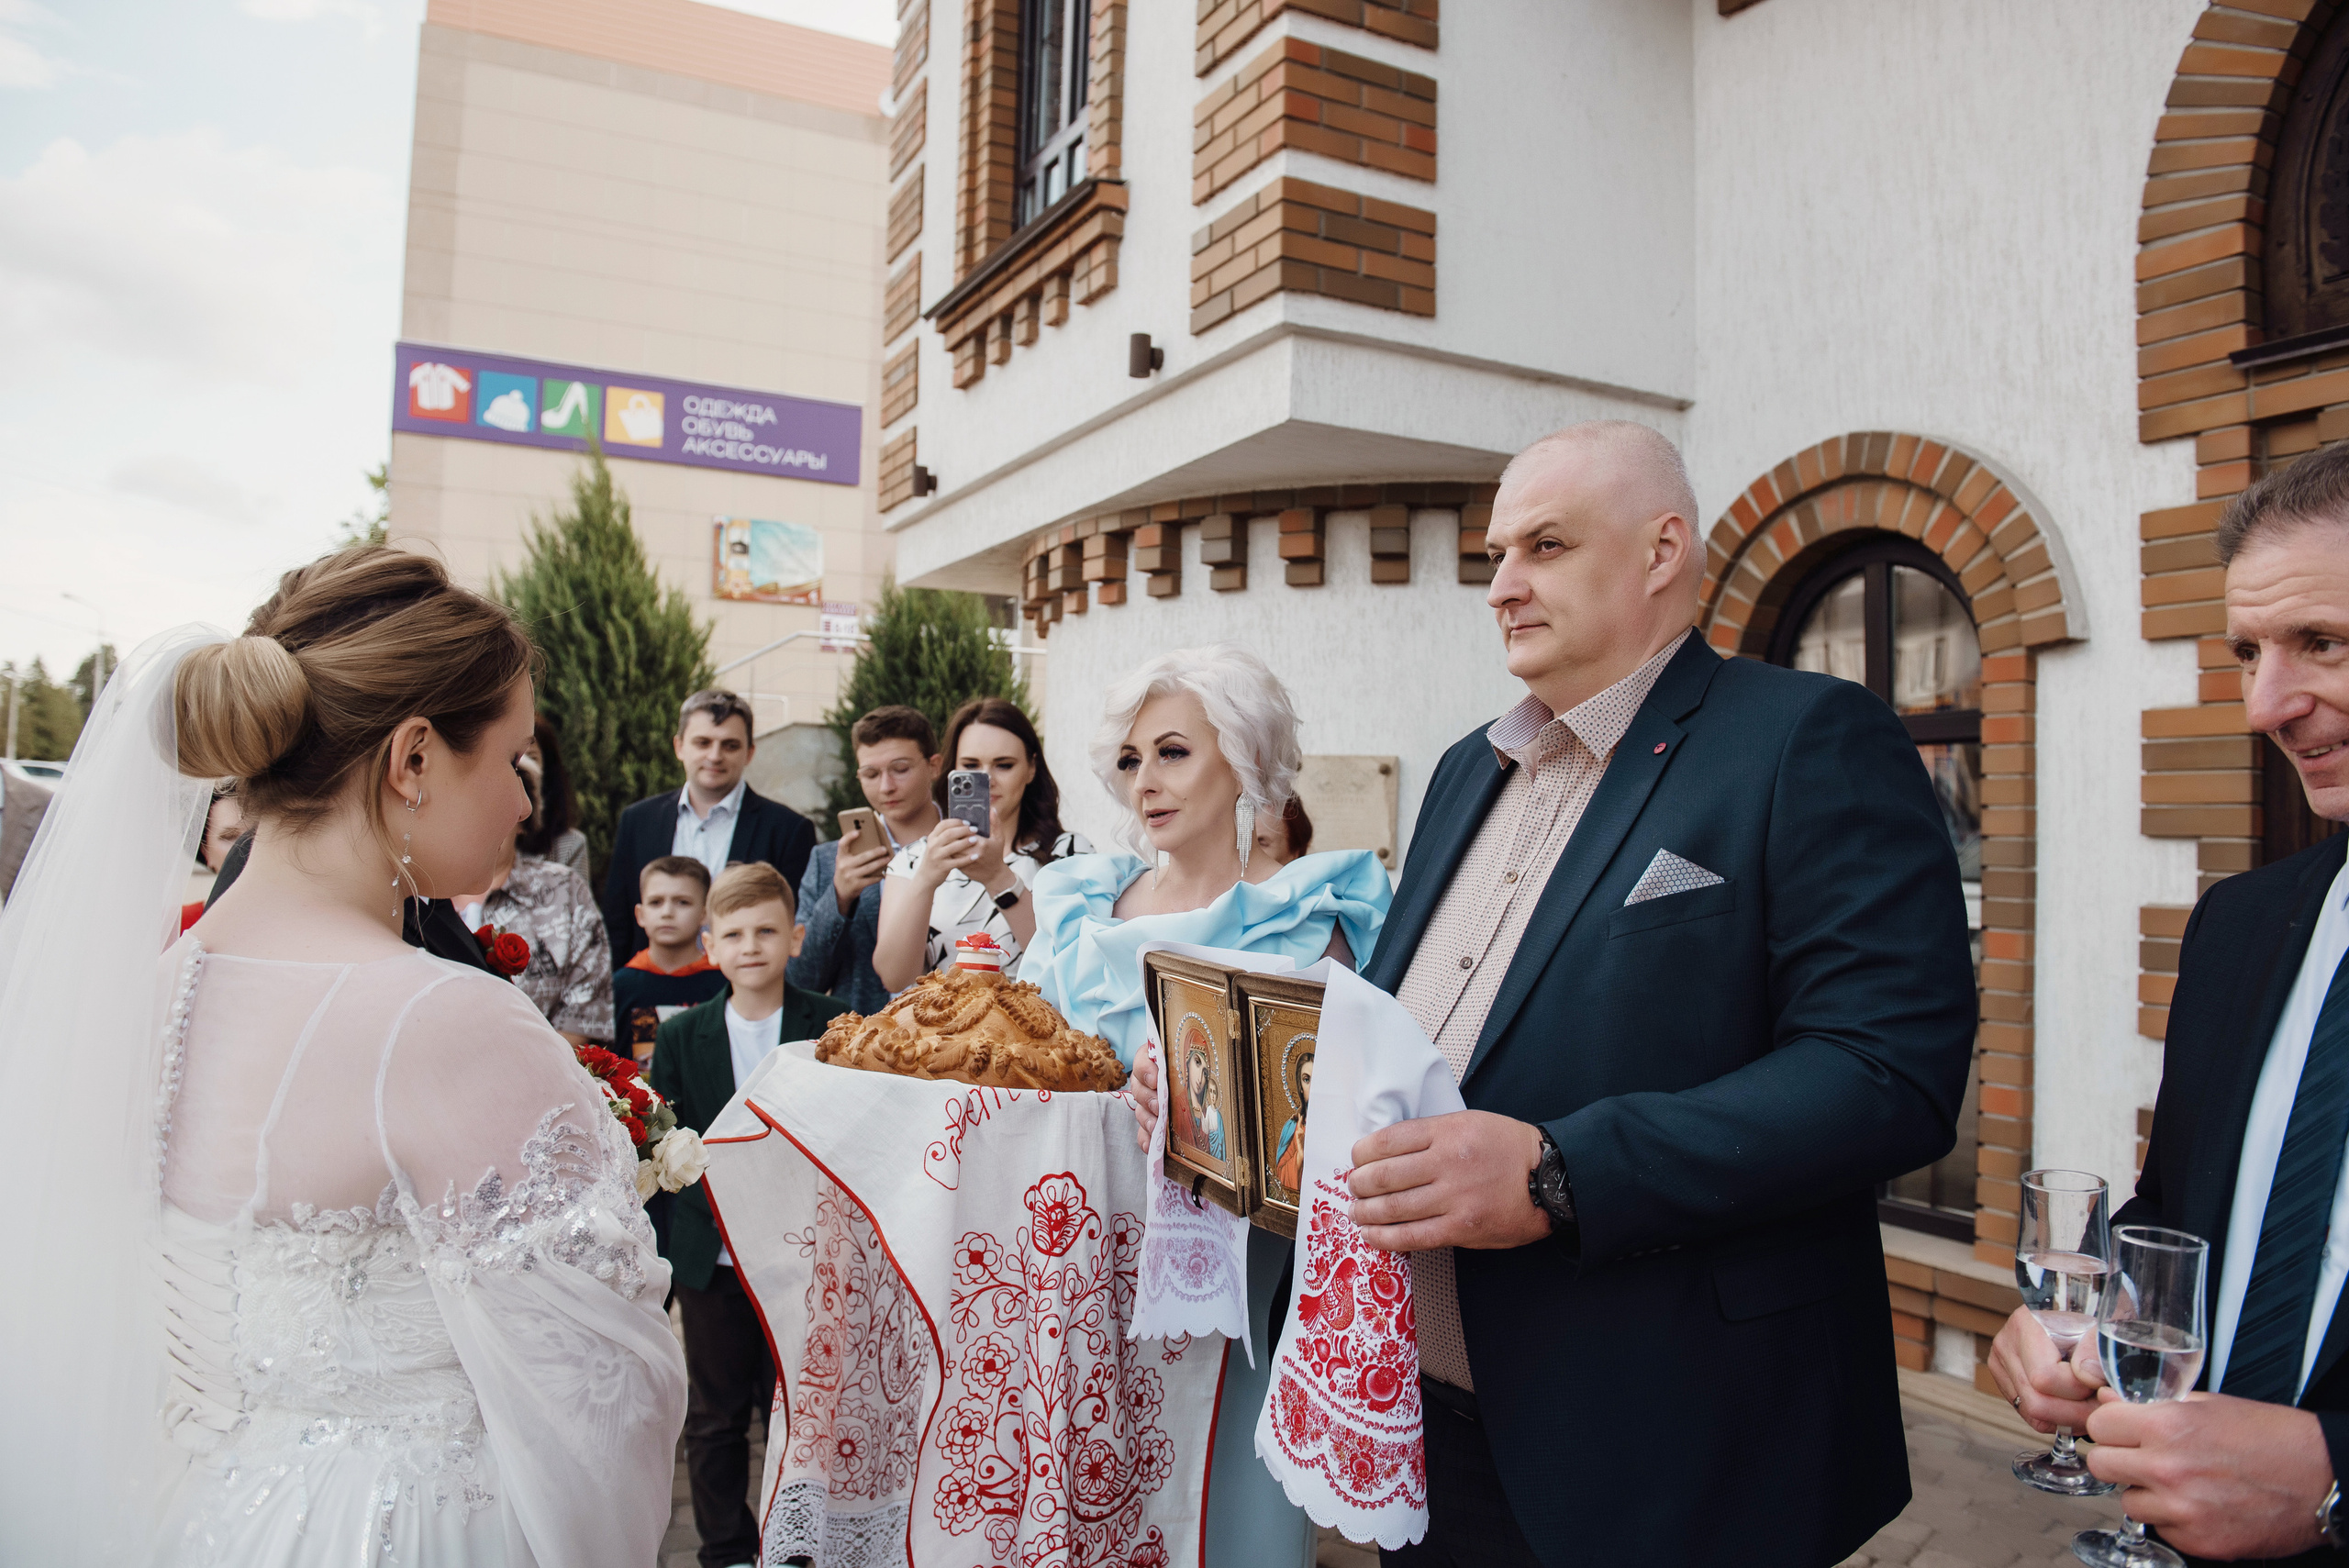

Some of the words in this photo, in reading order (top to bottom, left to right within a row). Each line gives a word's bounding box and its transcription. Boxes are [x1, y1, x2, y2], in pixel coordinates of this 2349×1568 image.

[683, 395, 778, 426] ОДЕЖДА
[682, 416, 754, 441] ОБУВЬ
[681, 436, 828, 471] АКСЕССУАРЫ
